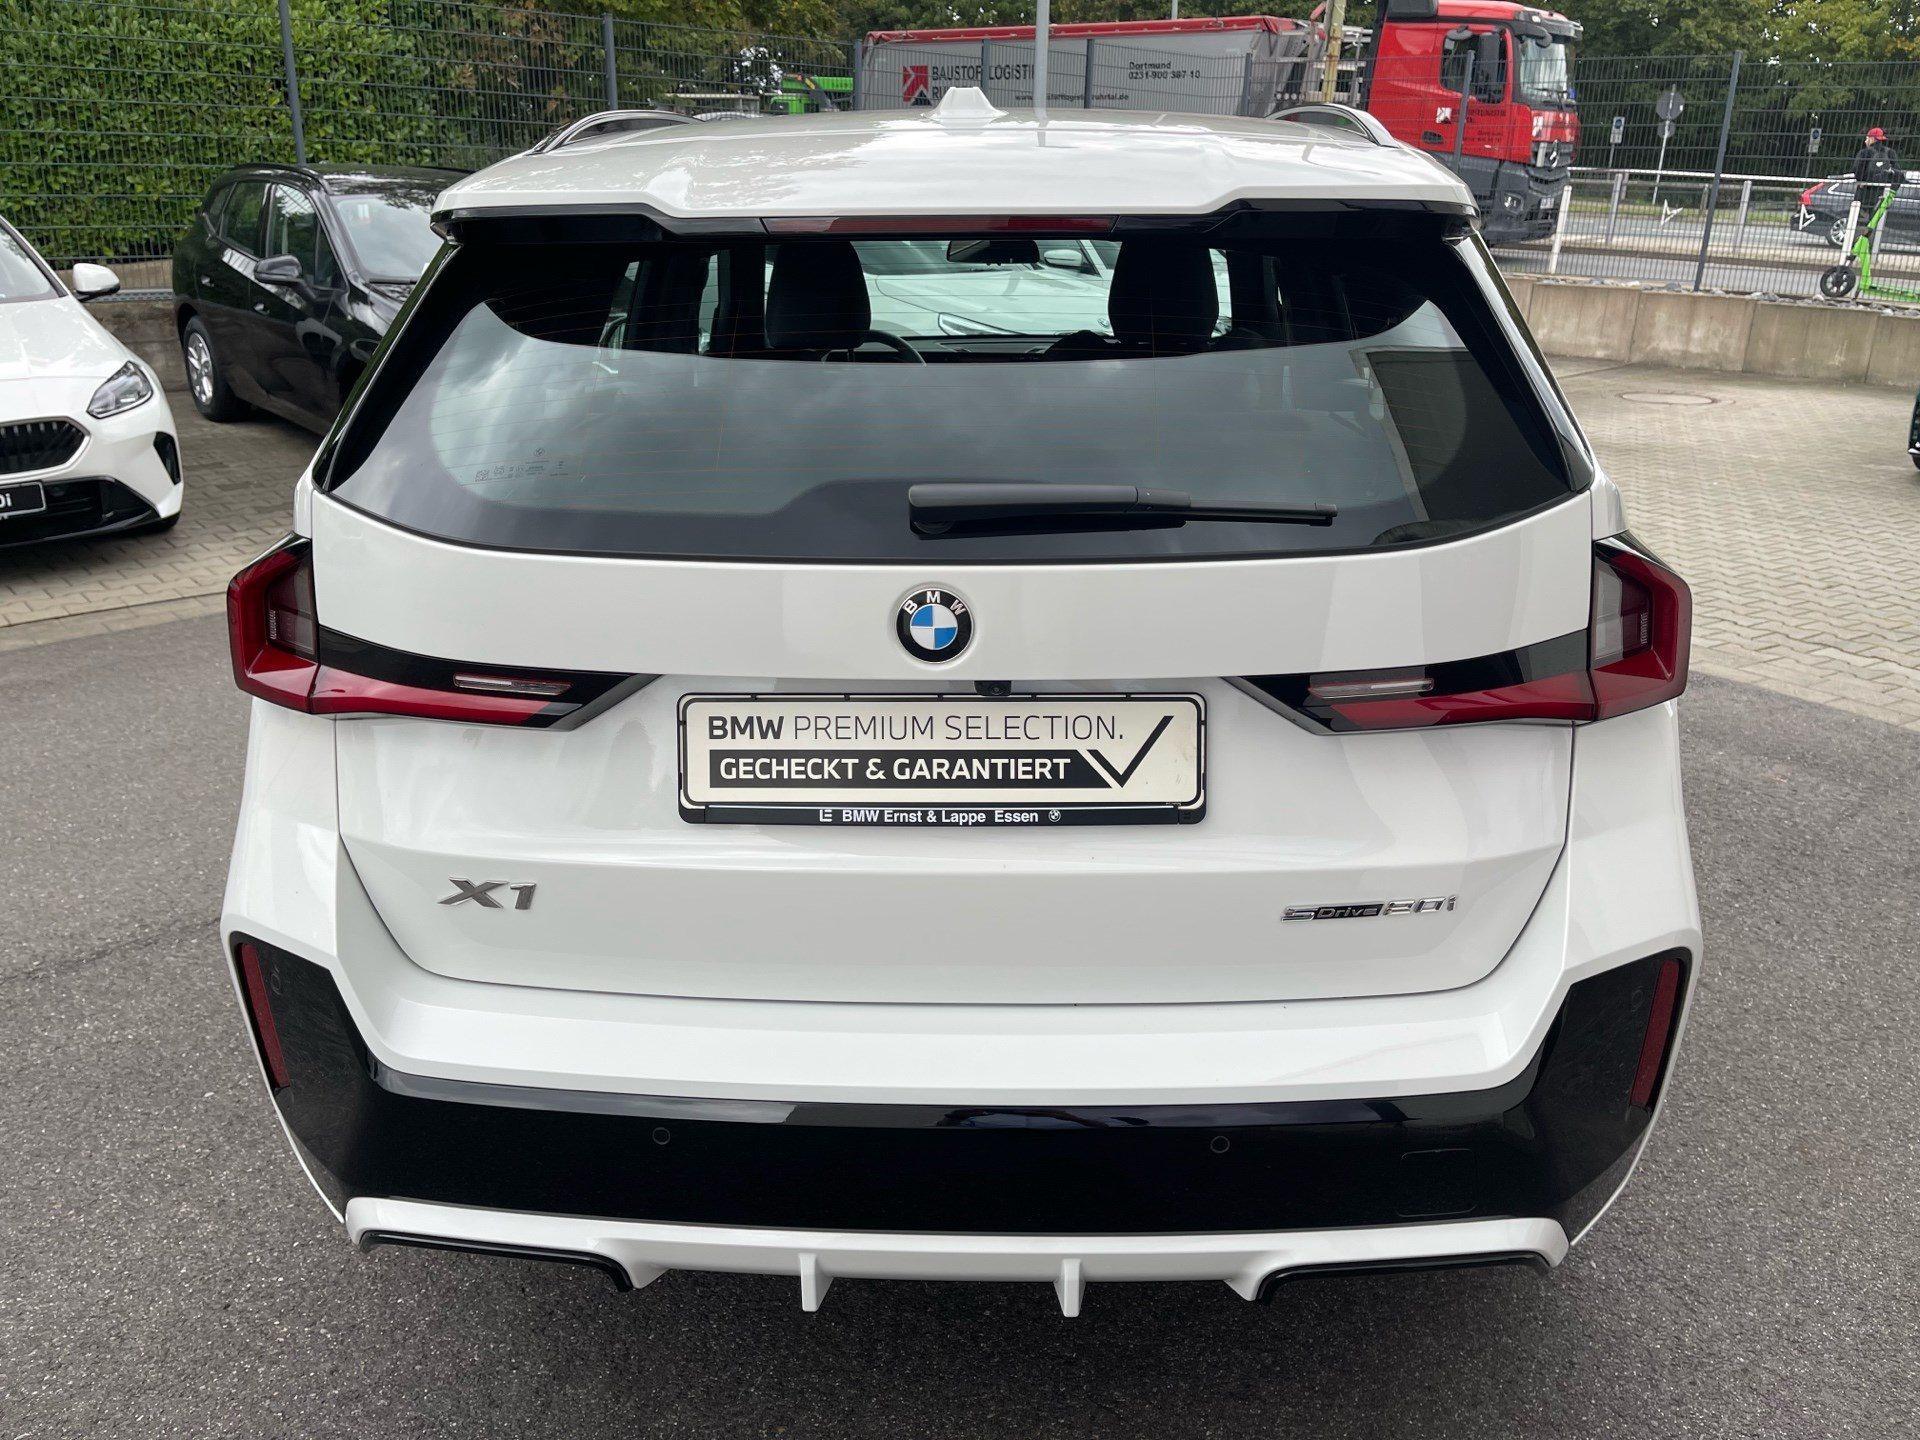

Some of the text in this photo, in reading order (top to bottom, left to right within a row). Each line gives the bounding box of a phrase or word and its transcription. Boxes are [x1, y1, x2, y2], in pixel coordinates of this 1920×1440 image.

[1129, 61, 1171, 70] Dortmund
[902, 590, 967, 616] BMW
[708, 715, 1124, 740] BMW PREMIUM SELECTION.
[719, 757, 1071, 781] GECHECKT & GARANTIERT
[842, 809, 880, 823] BMW
[884, 809, 923, 823] Ernst
[926, 809, 937, 823] &
[941, 809, 986, 826] Lappe
[994, 809, 1039, 823] Essen
[438, 878, 536, 910] X1
